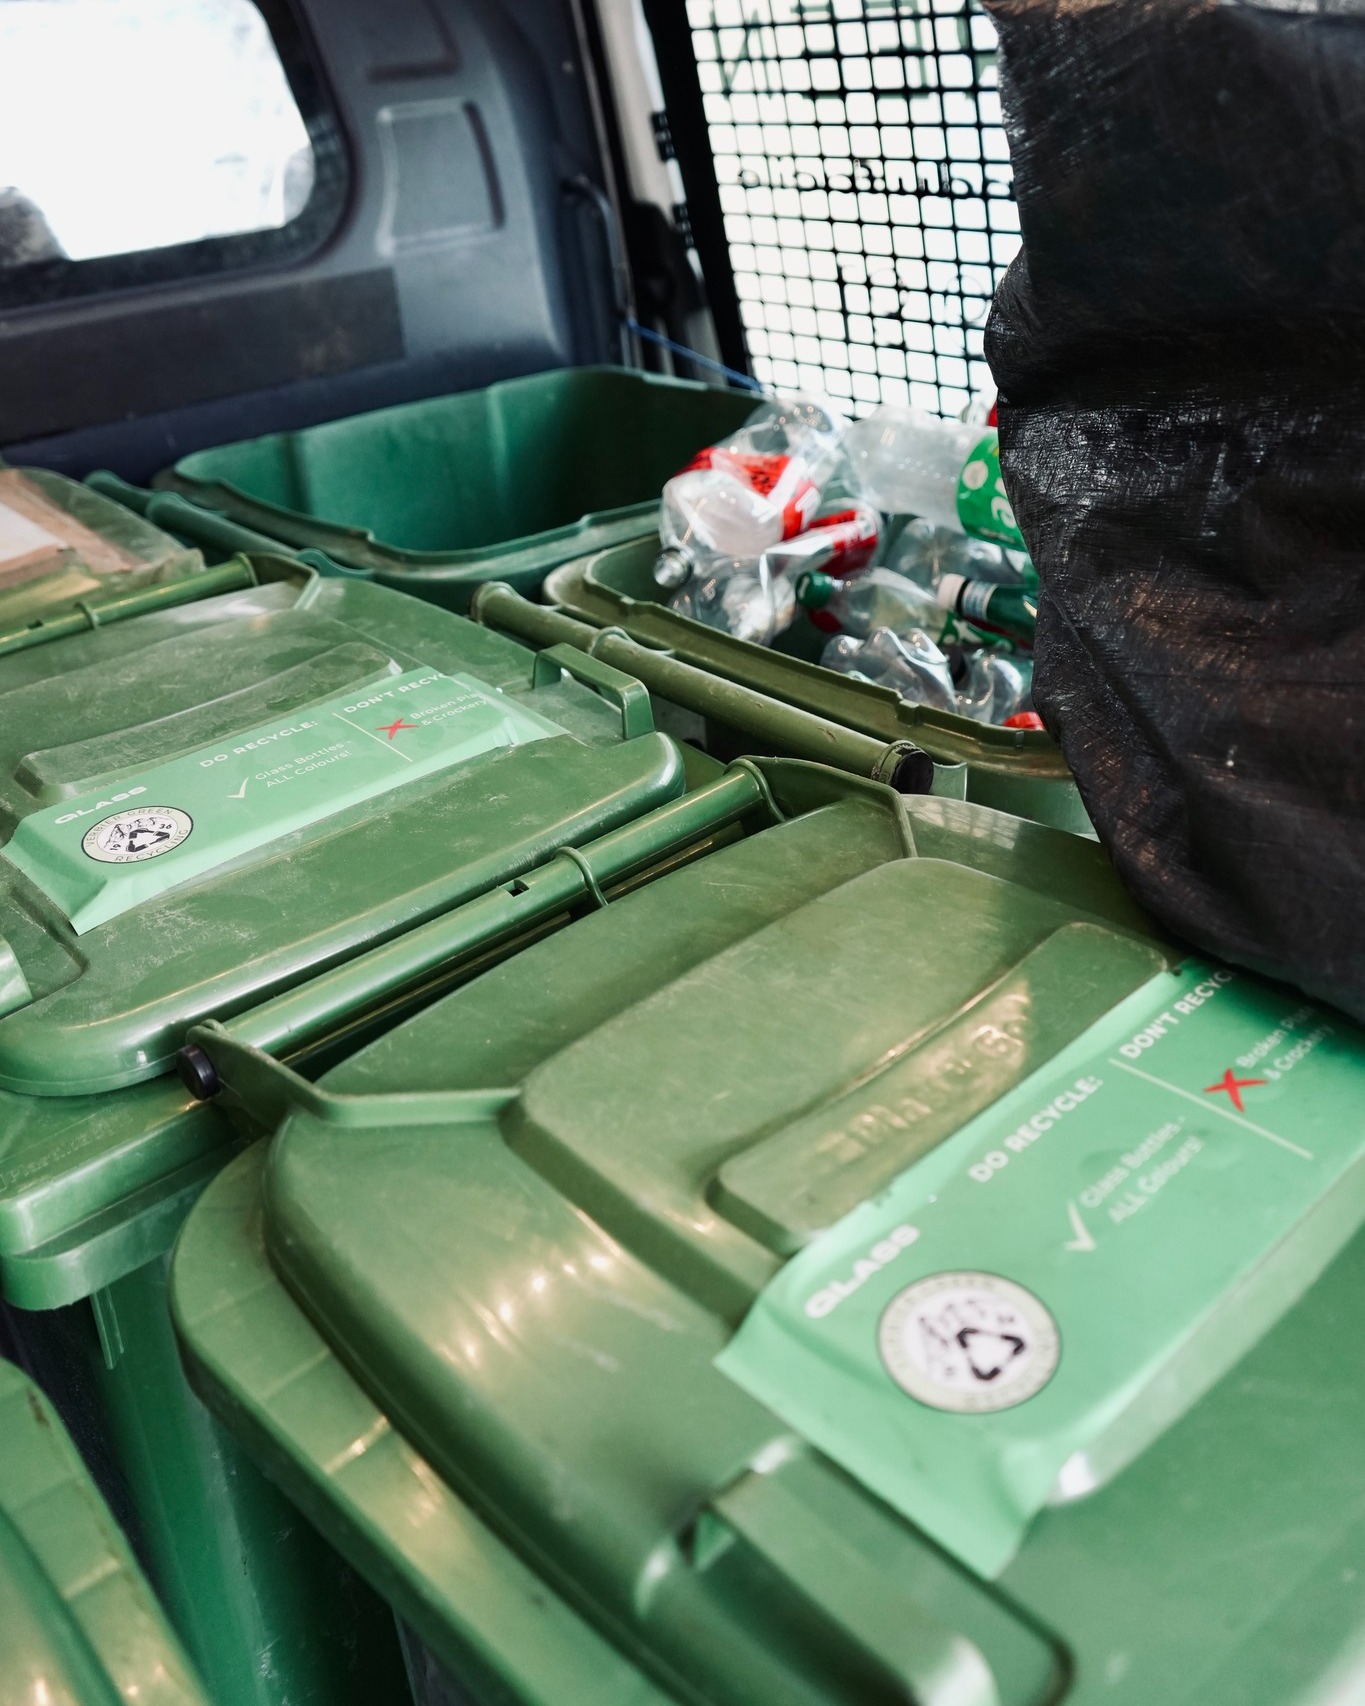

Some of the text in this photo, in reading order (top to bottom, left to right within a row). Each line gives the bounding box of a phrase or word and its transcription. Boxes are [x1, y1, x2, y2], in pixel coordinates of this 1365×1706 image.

[343, 691, 395, 713] DON'T
[410, 699, 456, 719] Broken
[432, 699, 488, 722] Crockery
[199, 720, 319, 768] DO RECYCLE:
[255, 763, 294, 780] Glass
[294, 742, 345, 765] Bottles
[266, 750, 353, 788] ALL Colours!
[55, 786, 147, 825] GLASS
[85, 808, 173, 848] VERBIER GREEN
[114, 829, 189, 862] RECYCLING
[1119, 1012, 1180, 1059] DON'T
[1235, 1027, 1290, 1069] Broken
[1273, 1024, 1335, 1071] Crockery
[967, 1075, 1104, 1183] DO RECYCLE:
[1079, 1166, 1130, 1208] Glass
[1120, 1121, 1182, 1169] Bottles
[1107, 1191, 1148, 1225] ALL
[804, 1224, 921, 1319] GLASS
